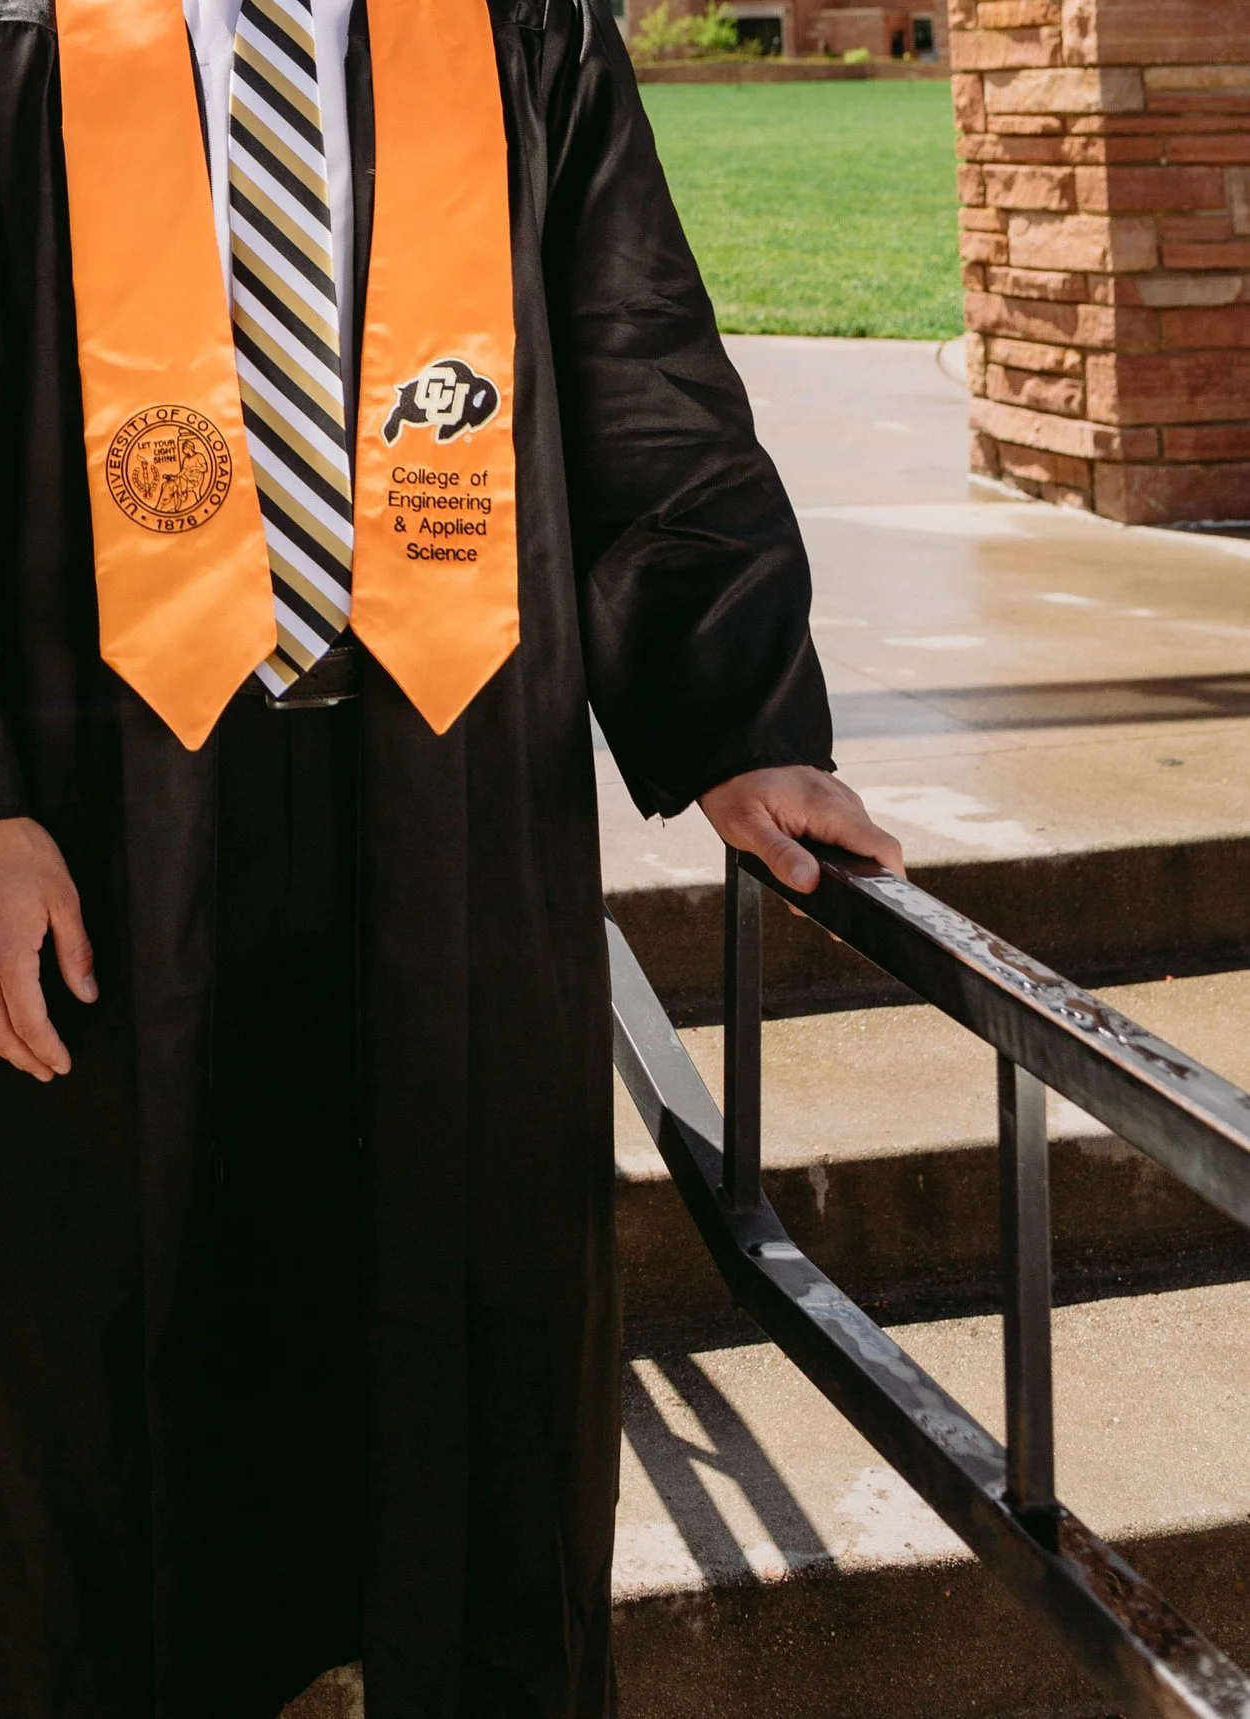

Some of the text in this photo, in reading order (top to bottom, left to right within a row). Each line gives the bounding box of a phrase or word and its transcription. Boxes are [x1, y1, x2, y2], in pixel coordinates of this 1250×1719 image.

[414, 367, 470, 425] CU
[137, 439, 176, 450] LET YOUR
[153, 447, 176, 456] LIGHT
[109, 408, 229, 516] UNIVERSITY OF COLORADO
[391, 466, 488, 489] College of
[388, 490, 492, 514] Engineering
[156, 515, 198, 531] 1876
[393, 515, 487, 538] & Applied
[406, 542, 478, 562] Science
